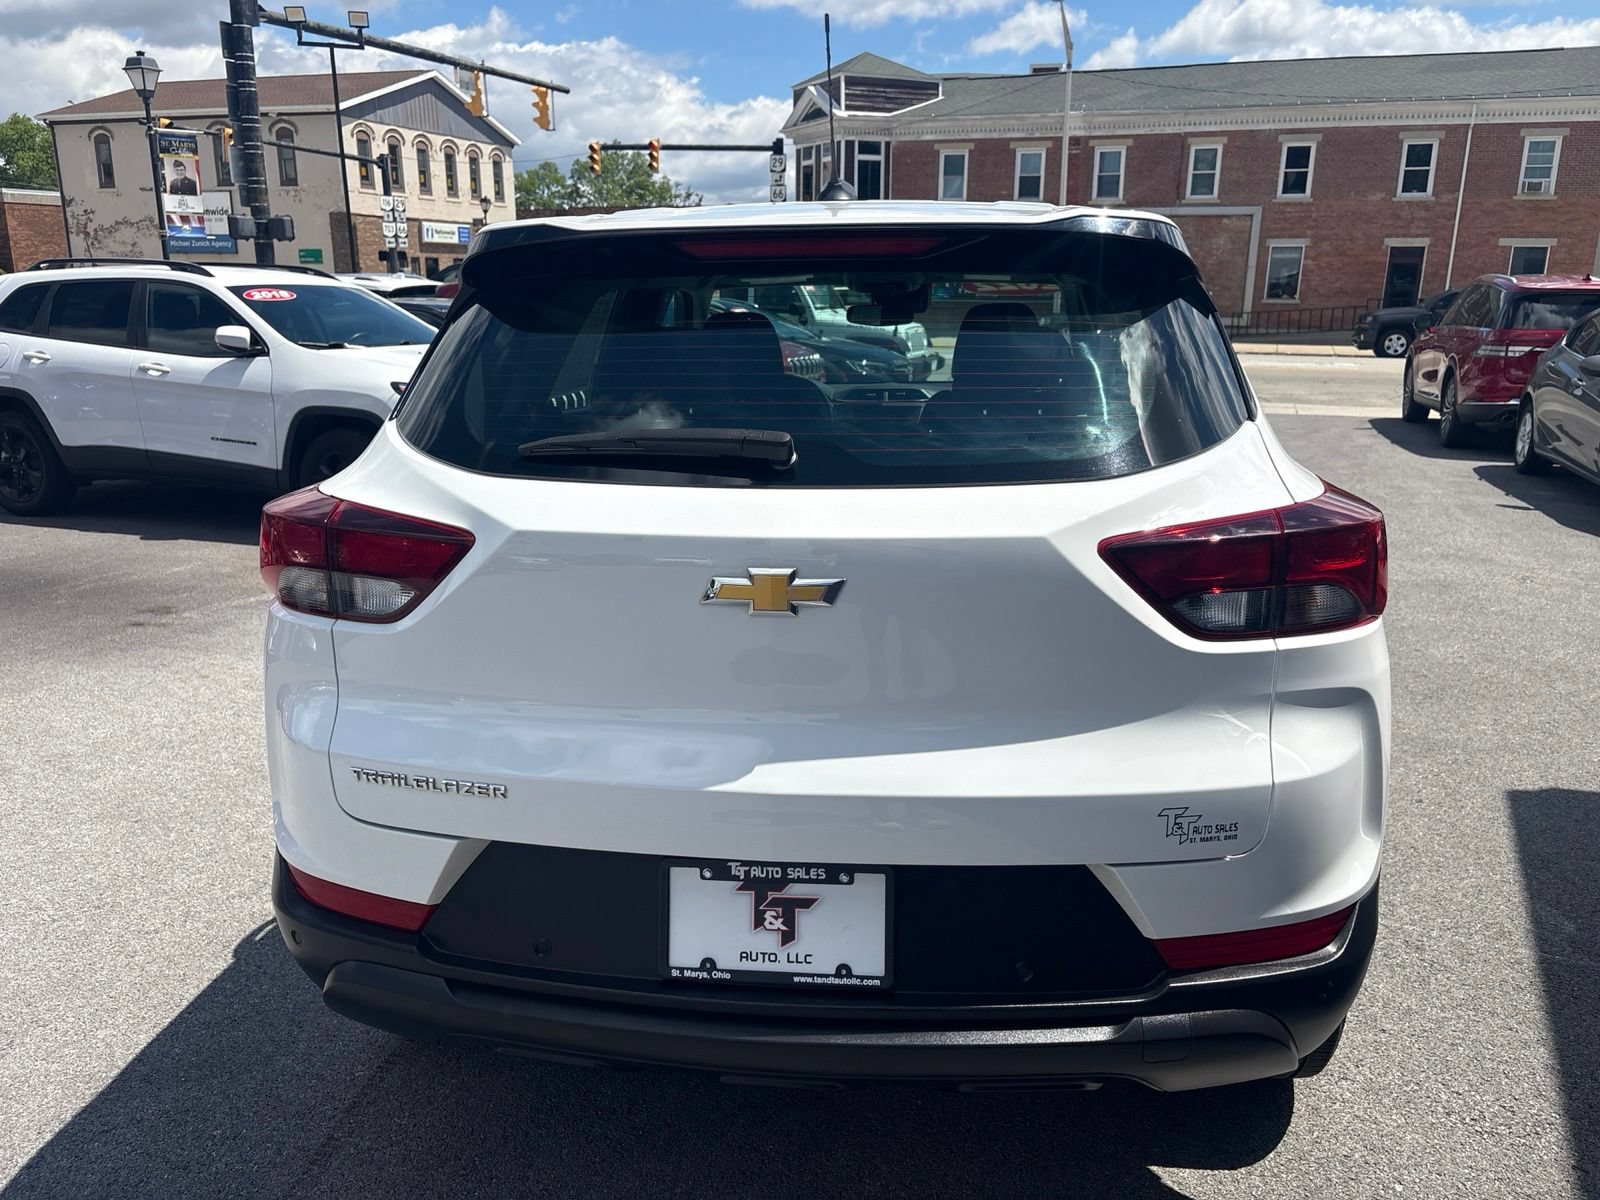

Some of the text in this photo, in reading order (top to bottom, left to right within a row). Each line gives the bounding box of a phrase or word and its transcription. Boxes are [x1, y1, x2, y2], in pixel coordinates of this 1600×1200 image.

[772, 157, 784, 168] 29
[772, 189, 784, 200] 66
[395, 199, 405, 208] 29
[399, 225, 406, 235] 66
[211, 240, 232, 248] Agency
[210, 437, 257, 446] CHEROKEE
[350, 766, 507, 799] TRAILBLAZER
[1157, 807, 1203, 846] T&T
[1192, 822, 1239, 836] AUTO SALES
[750, 866, 782, 879] AUTO
[786, 867, 826, 880] SALES
[786, 952, 813, 964] LLC
[671, 969, 731, 979] St. Marys, Ohio
[793, 976, 881, 986] www.tandtautollc.com
